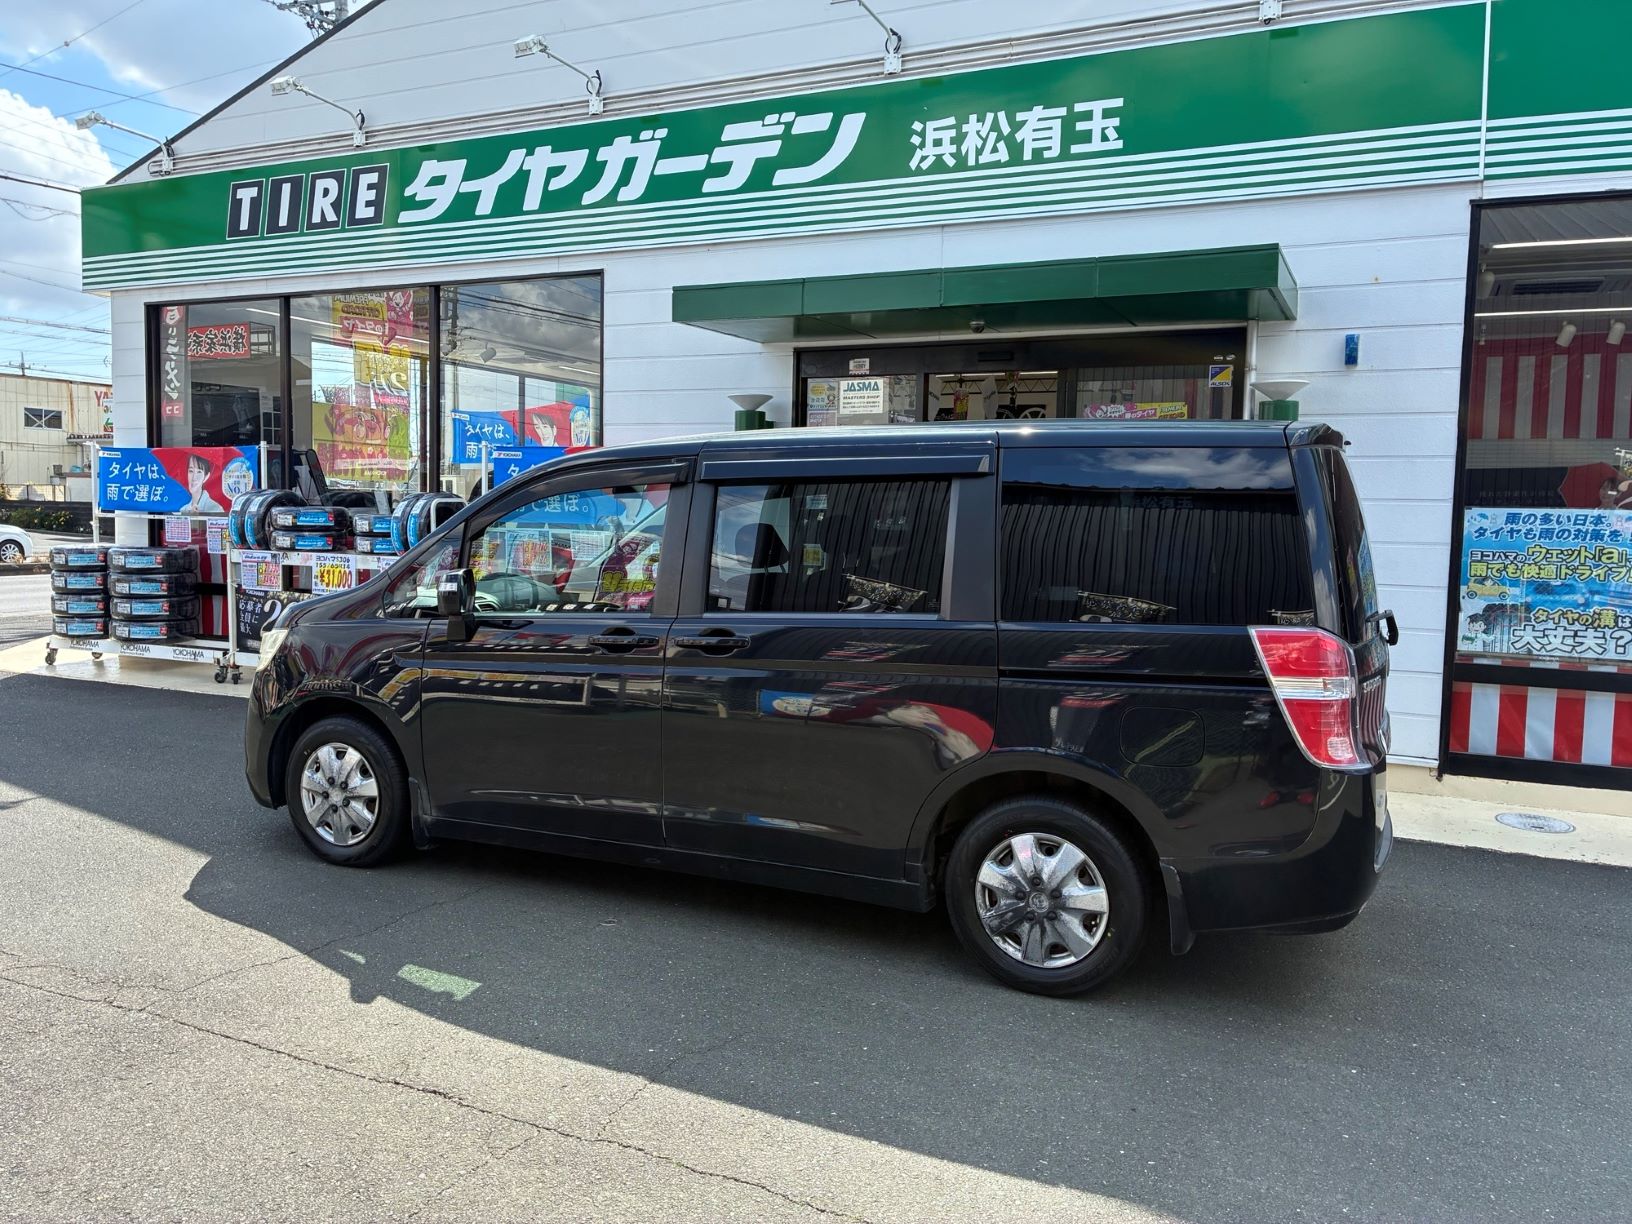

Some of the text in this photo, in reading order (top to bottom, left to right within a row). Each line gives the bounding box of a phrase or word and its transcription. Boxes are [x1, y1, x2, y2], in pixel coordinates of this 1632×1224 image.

[235, 97, 1124, 231] TIRE タイヤガーデン 浜松有玉
[843, 381, 880, 392] JASMA
[109, 461, 166, 480] タイヤは、
[107, 483, 168, 502] 雨で選ぼ。
[515, 494, 589, 513] で選ぼ。
[1504, 512, 1612, 528] 雨の多い日本。
[172, 648, 205, 658] YOKOHAMA
